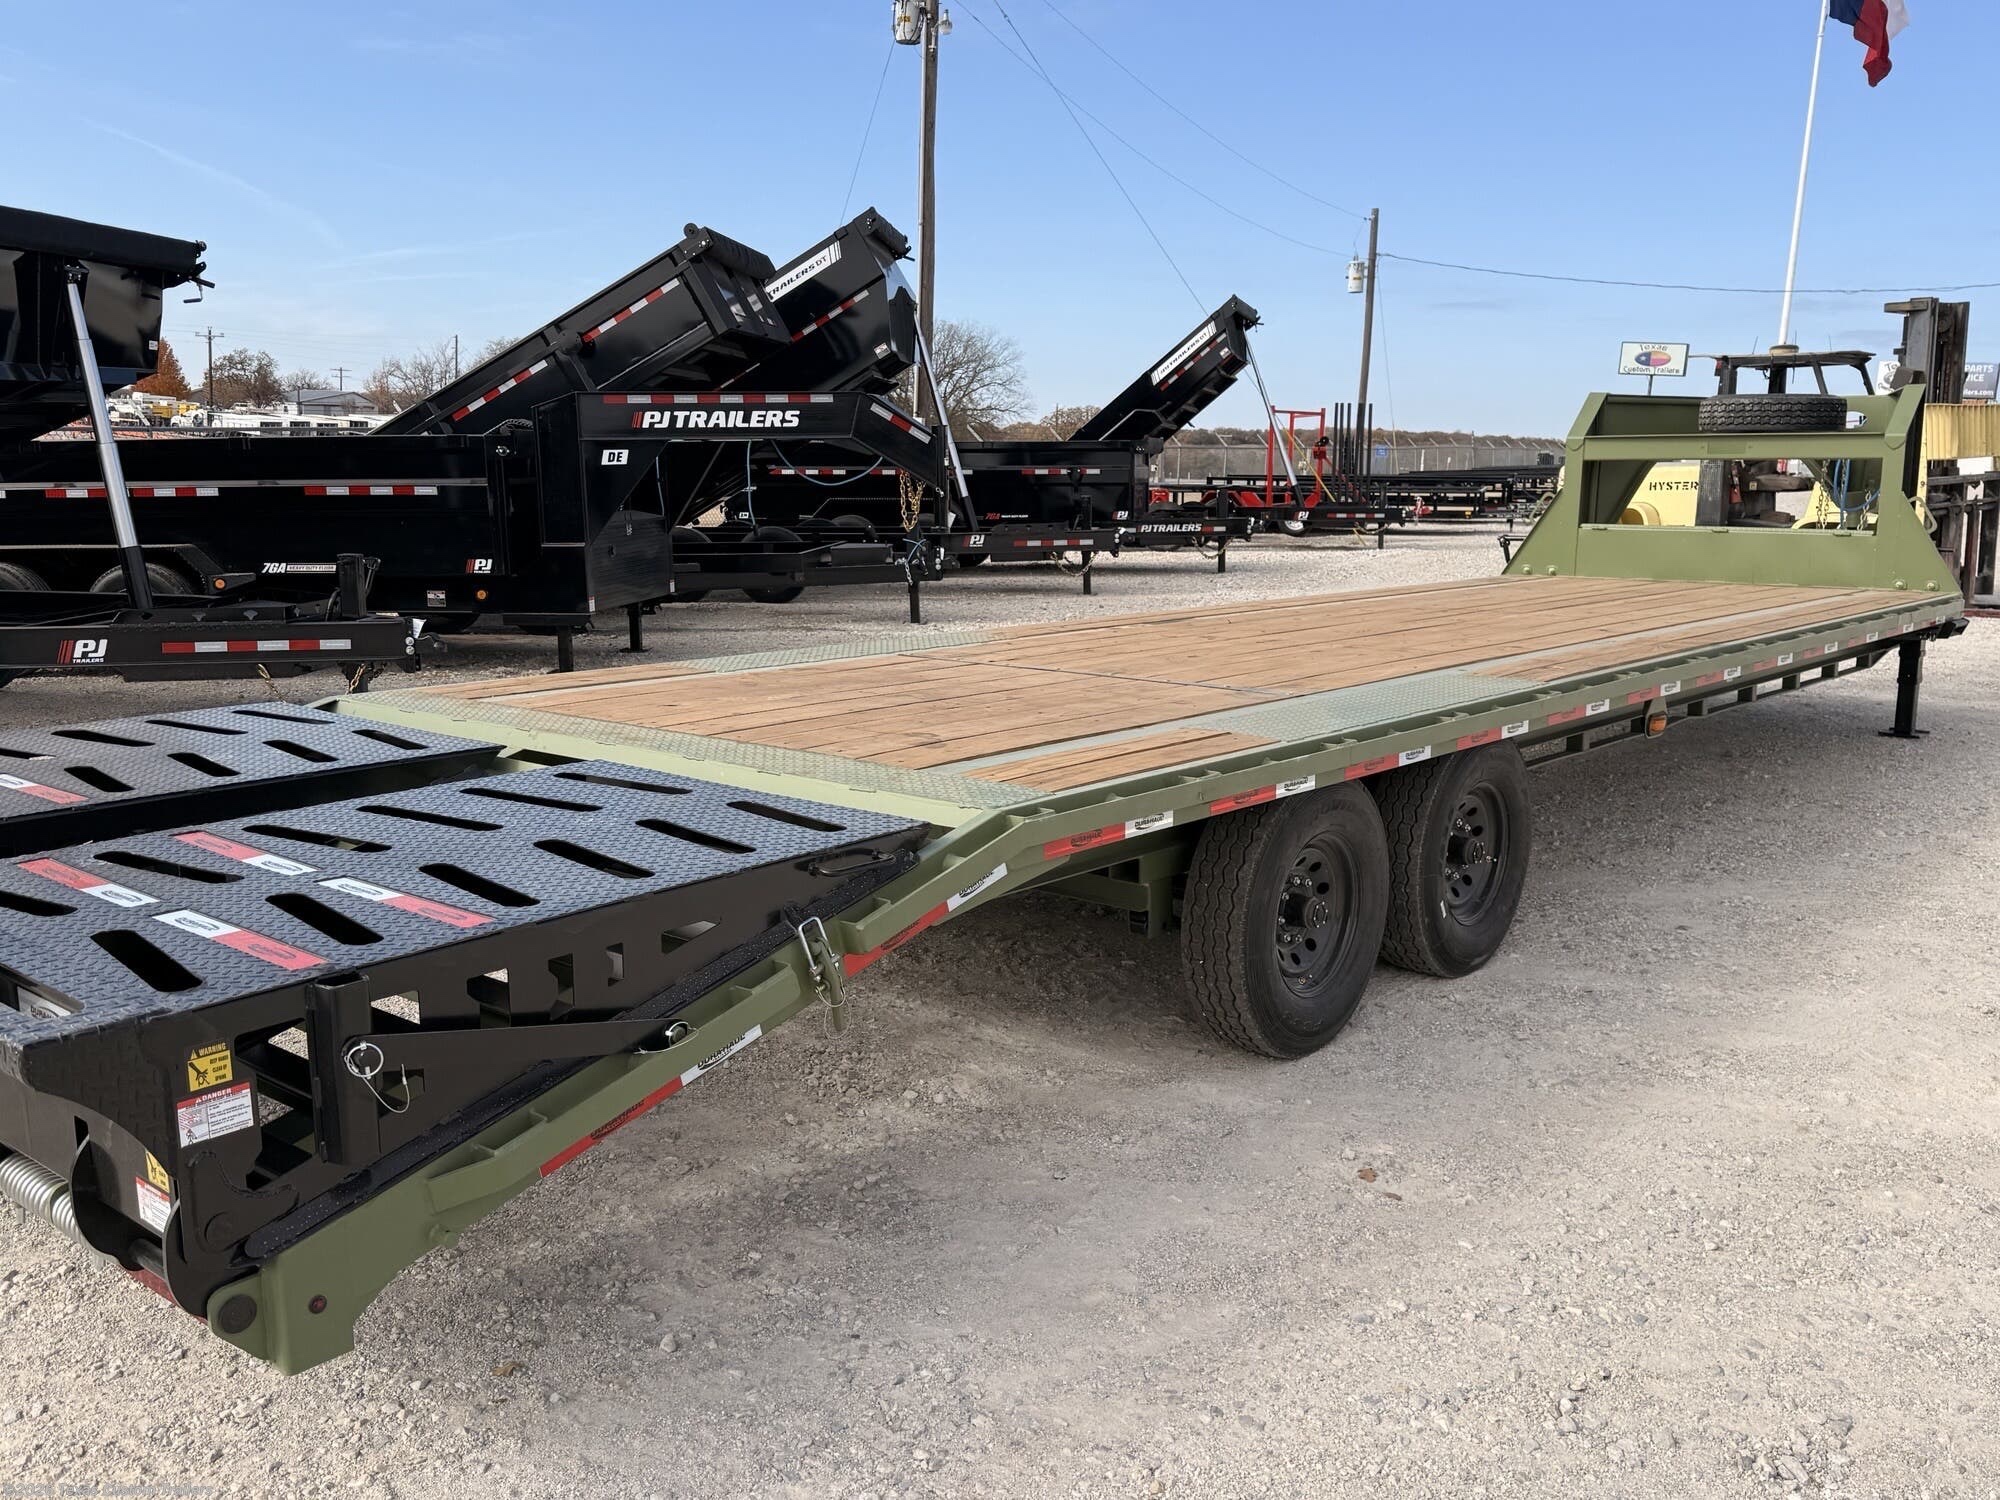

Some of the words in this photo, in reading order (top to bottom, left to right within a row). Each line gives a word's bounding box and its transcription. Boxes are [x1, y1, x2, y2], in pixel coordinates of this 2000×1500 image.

[1965, 364, 1994, 373] PARTS
[1966, 374, 1985, 382] VICE
[642, 411, 671, 428] PJ
[673, 410, 800, 428] TRAILERS
[607, 452, 623, 463] DE
[1649, 481, 1699, 491] HYSTER
[1141, 525, 1152, 533] PJ
[1153, 524, 1202, 533] TRAILERS
[969, 535, 985, 544] PJ
[261, 562, 286, 574] 7GA
[474, 559, 493, 570] PJ
[73, 639, 108, 658] PJ
[199, 1042, 227, 1056] WARNING
[202, 1087, 232, 1100] DANGER
